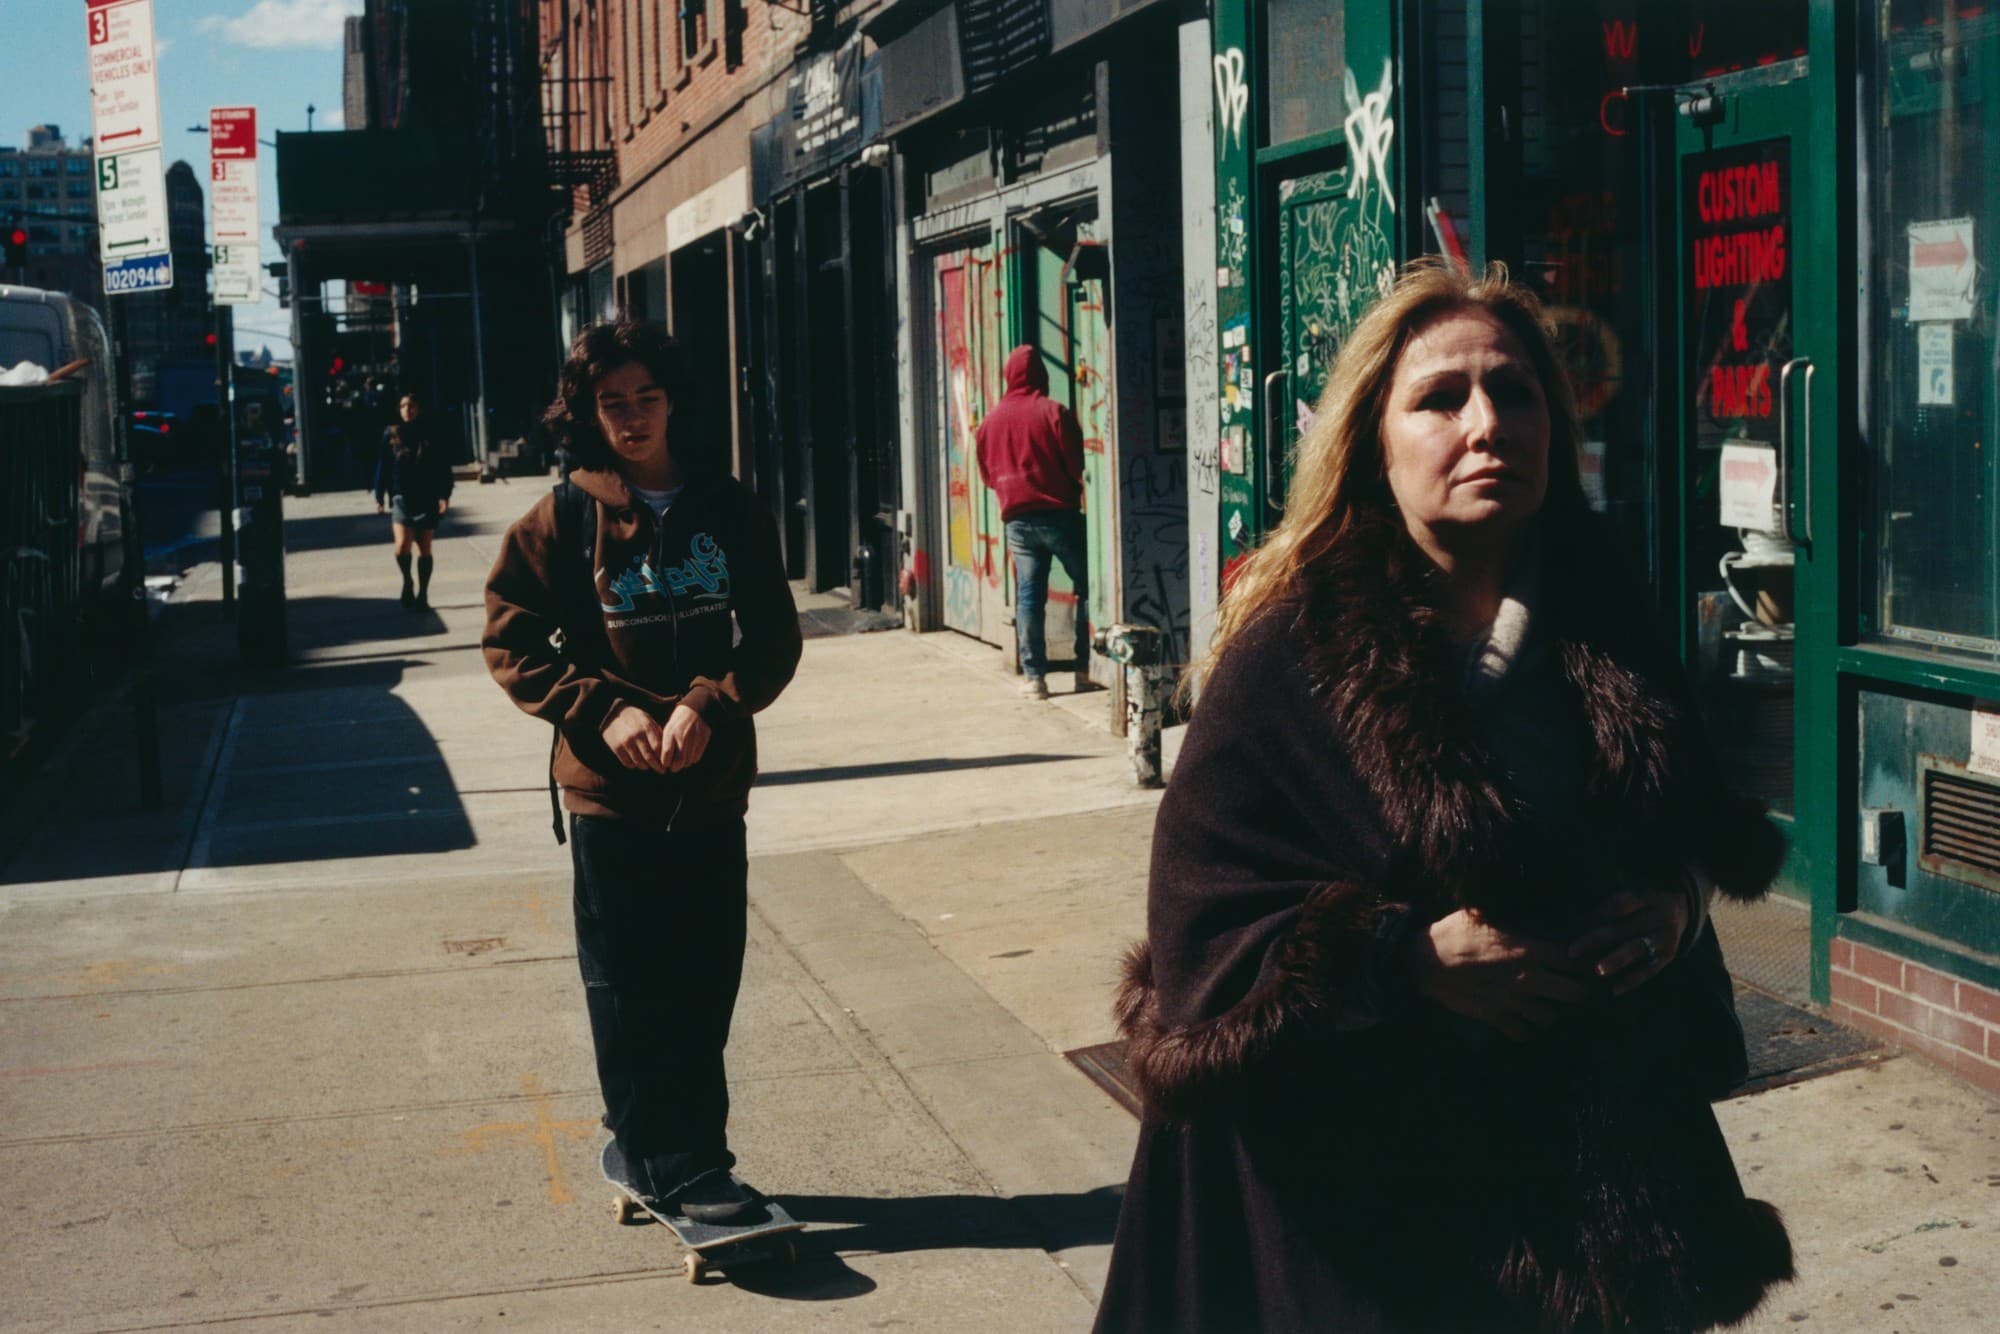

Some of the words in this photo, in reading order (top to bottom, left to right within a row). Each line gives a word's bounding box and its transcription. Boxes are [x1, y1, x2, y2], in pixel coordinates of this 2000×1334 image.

[93, 12, 105, 42] 3
[103, 158, 116, 189] 5
[1698, 161, 1779, 224] CUSTOM
[1695, 225, 1785, 288] LIGHTING
[107, 266, 154, 290] 102094
[1732, 298, 1748, 352] &
[1712, 362, 1772, 417] PARTS
[607, 611, 673, 629] SUBCONSCIOU
